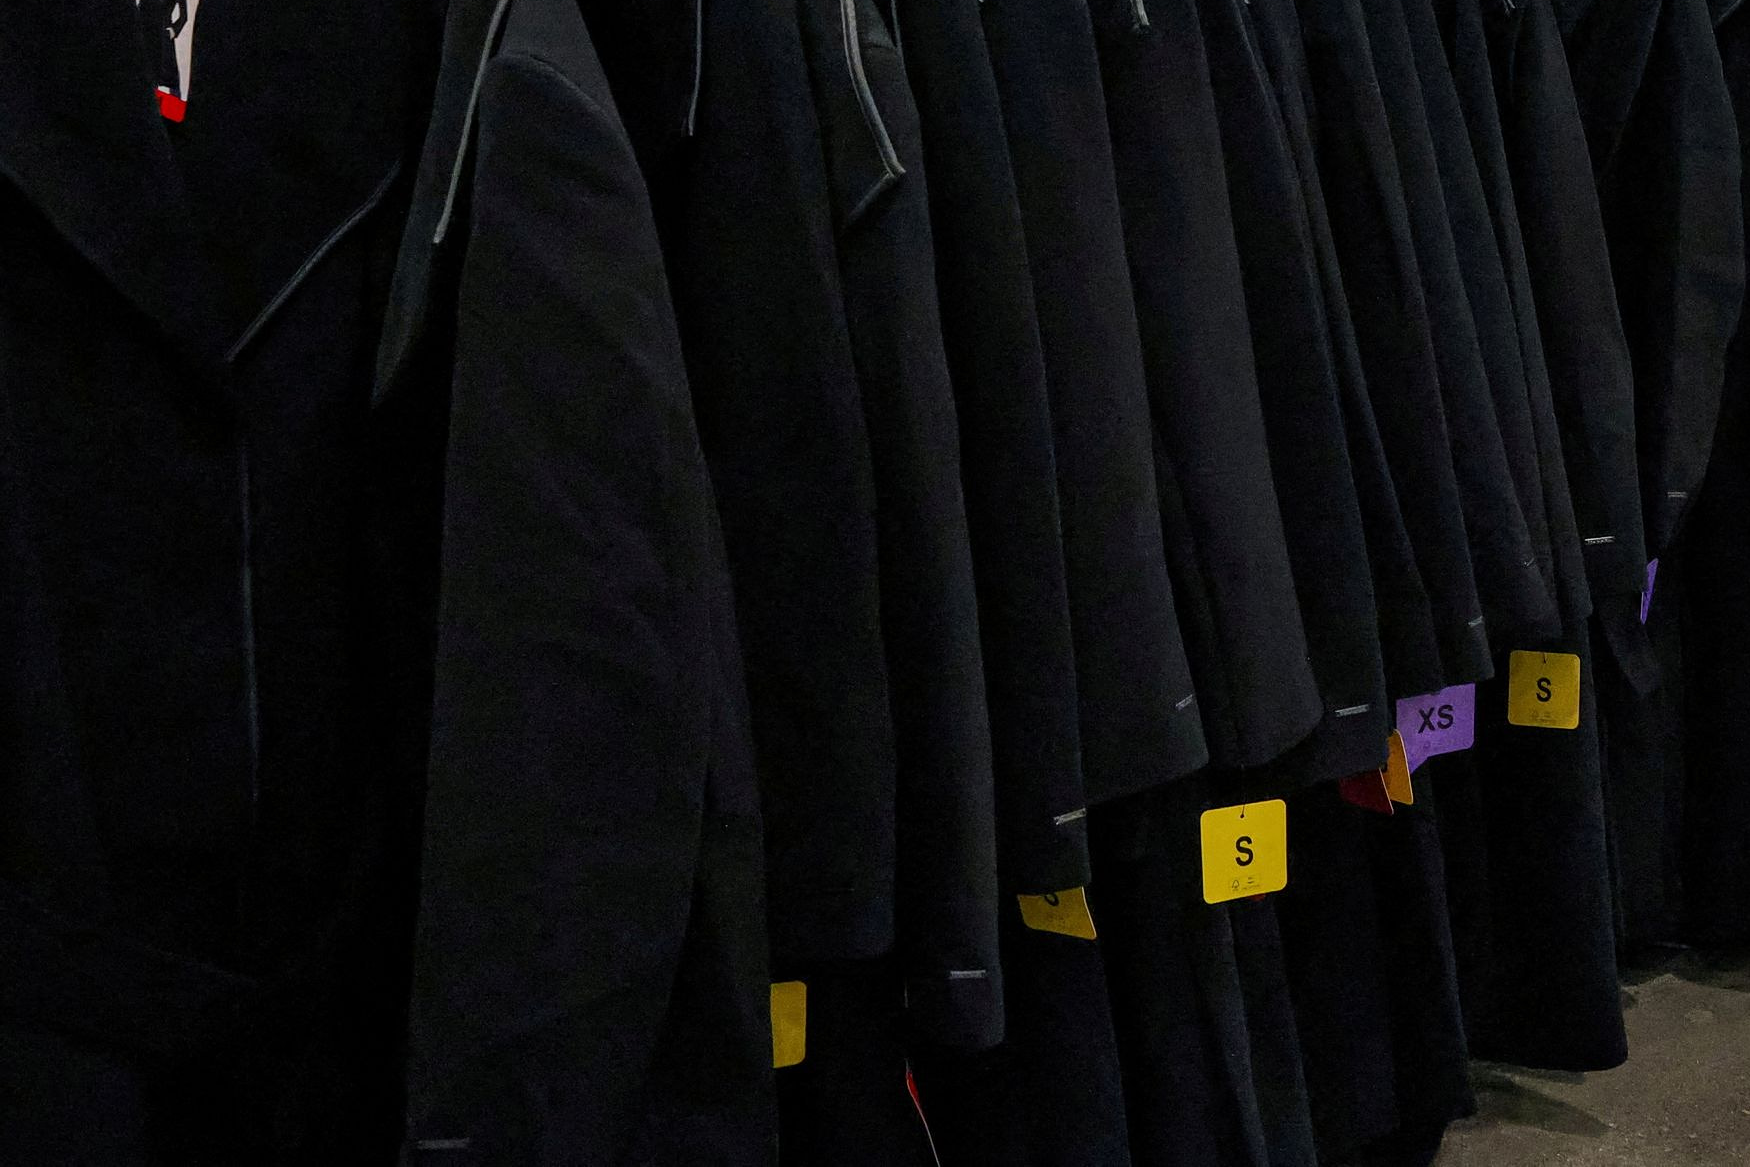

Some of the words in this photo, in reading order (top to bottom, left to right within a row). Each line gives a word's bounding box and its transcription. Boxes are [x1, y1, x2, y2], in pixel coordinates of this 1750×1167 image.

[1535, 677, 1552, 703] S
[1418, 704, 1454, 734] XS
[1234, 836, 1254, 868] S
